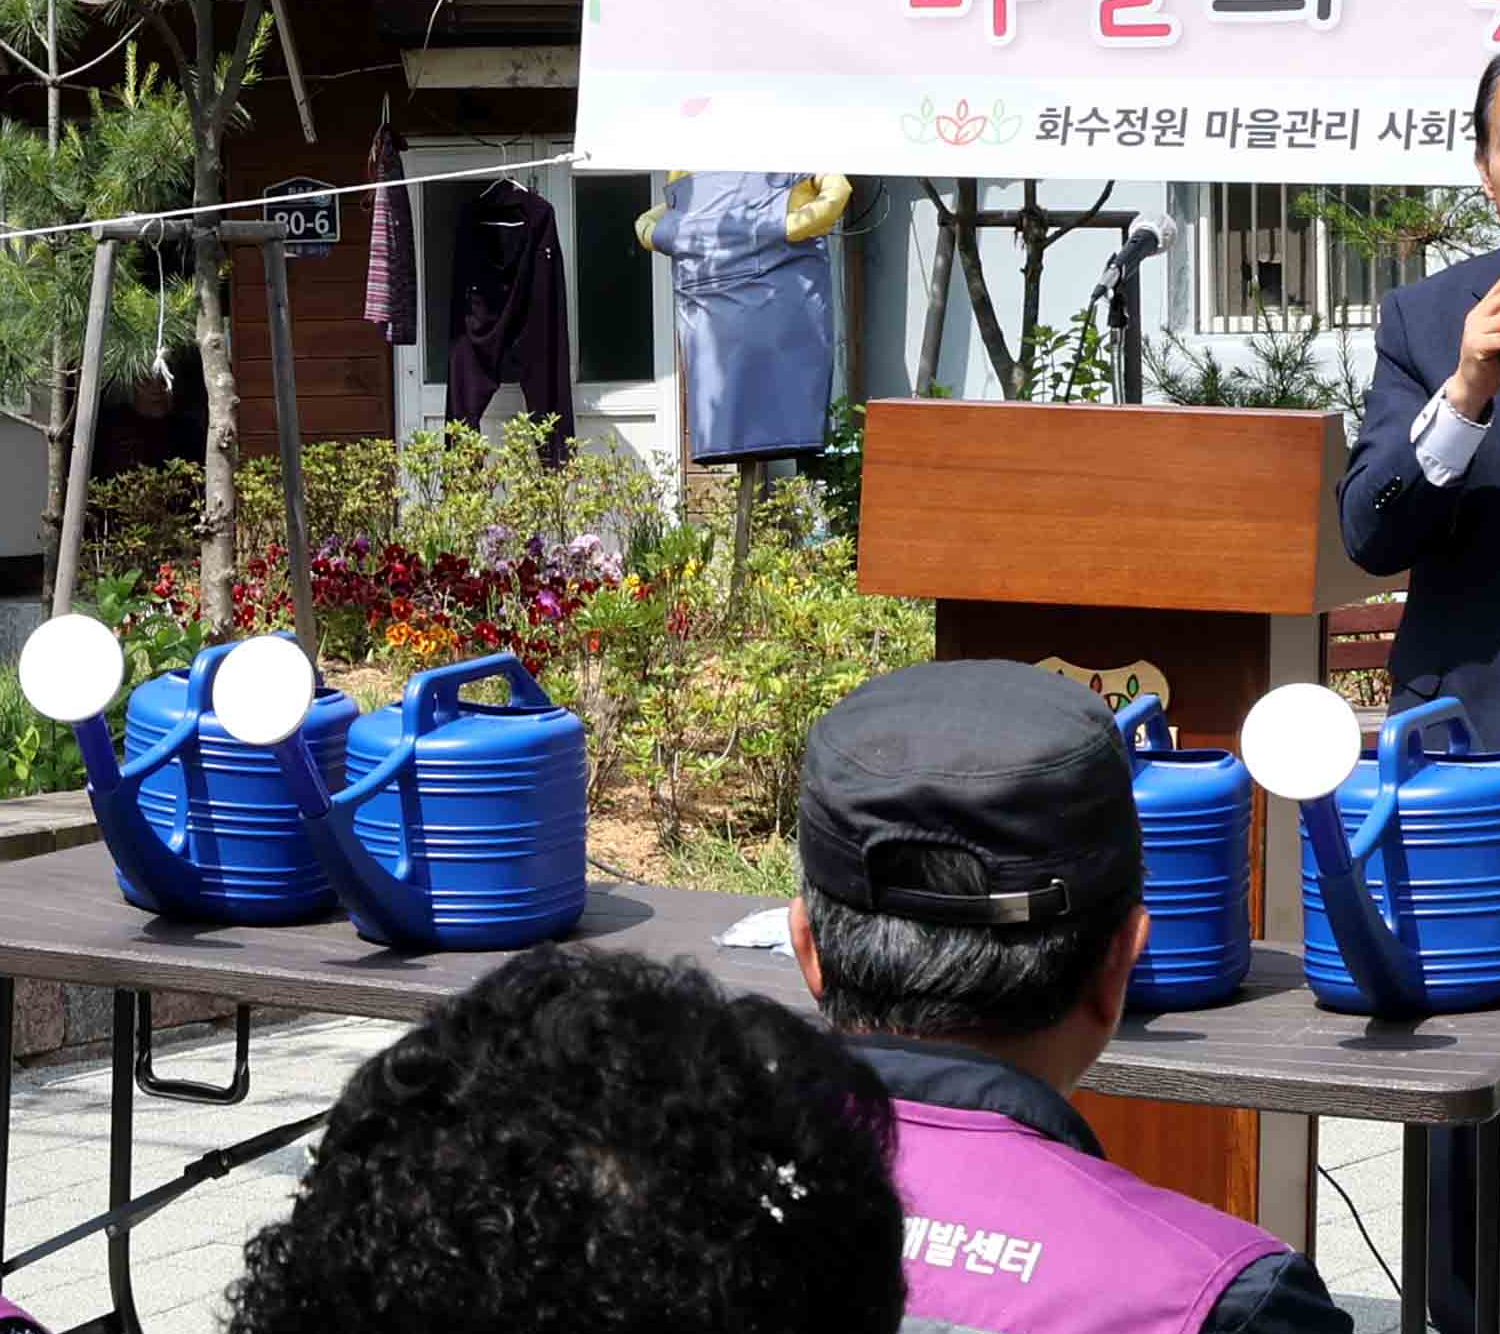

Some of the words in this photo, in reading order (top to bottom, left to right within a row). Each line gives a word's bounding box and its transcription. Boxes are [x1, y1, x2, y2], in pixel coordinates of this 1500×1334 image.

[1035, 105, 1188, 148] 화수정원
[1205, 106, 1360, 150] 마을관리
[274, 210, 329, 235] 80-6
